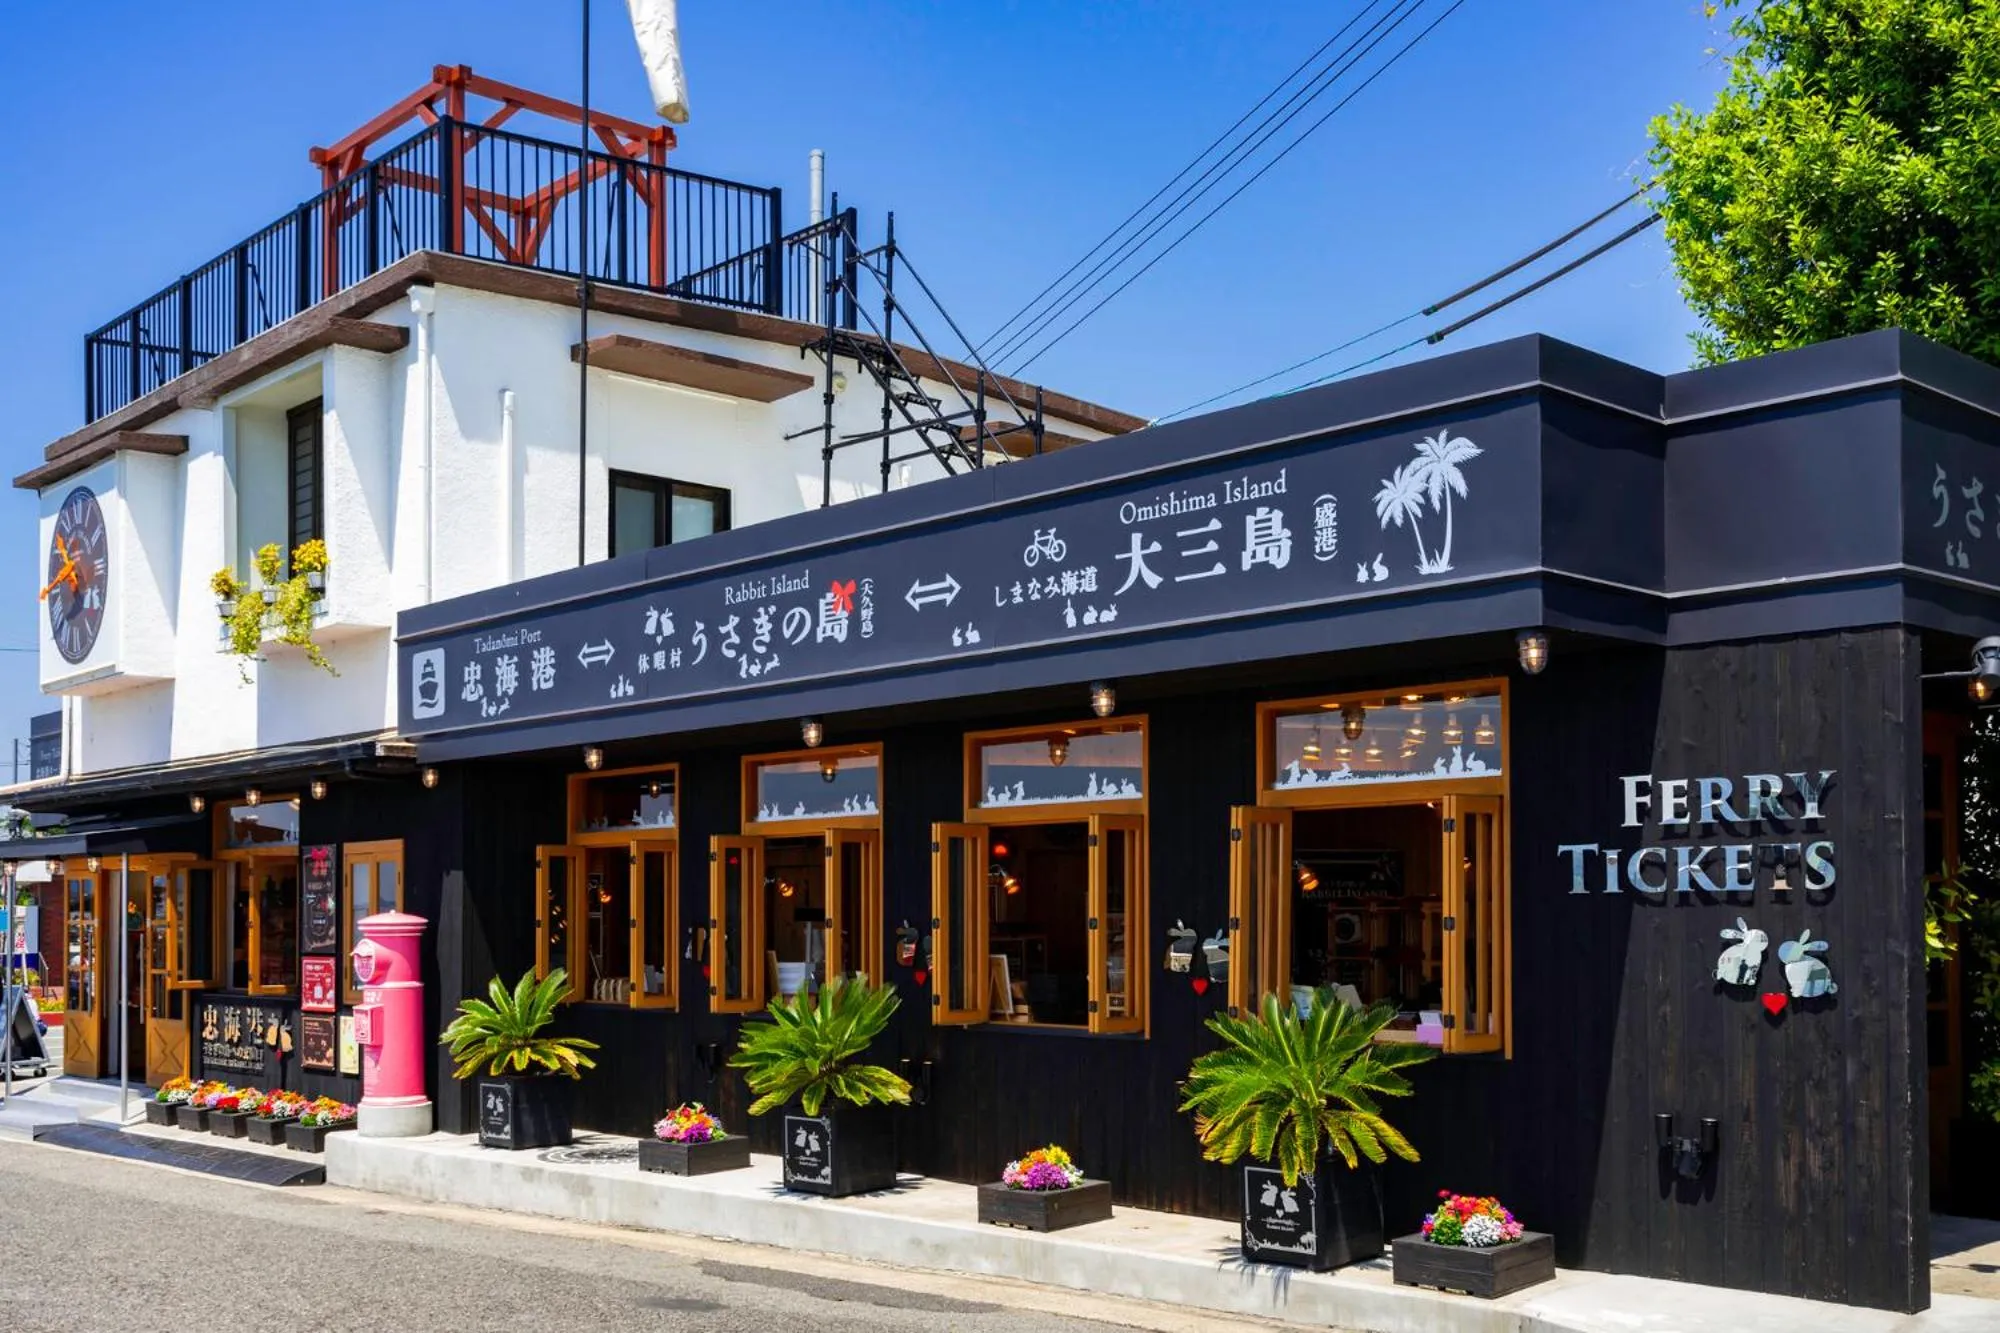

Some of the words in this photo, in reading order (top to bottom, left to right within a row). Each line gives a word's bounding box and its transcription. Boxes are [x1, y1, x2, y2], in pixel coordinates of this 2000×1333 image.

[1120, 490, 1216, 524] Omishima
[1224, 468, 1287, 505] Island
[1932, 462, 2000, 539] うさ
[1114, 507, 1292, 596] 大三島
[725, 579, 766, 606] Rabbit
[771, 569, 809, 590] Island
[994, 565, 1098, 607] しまなみ海道
[521, 628, 542, 645] Port
[691, 592, 849, 666] うさぎの島
[461, 646, 556, 702] 忠海港
[638, 647, 682, 675] 休暇村
[1619, 769, 1837, 828] FERRY
[1557, 841, 1837, 894] TICKETS
